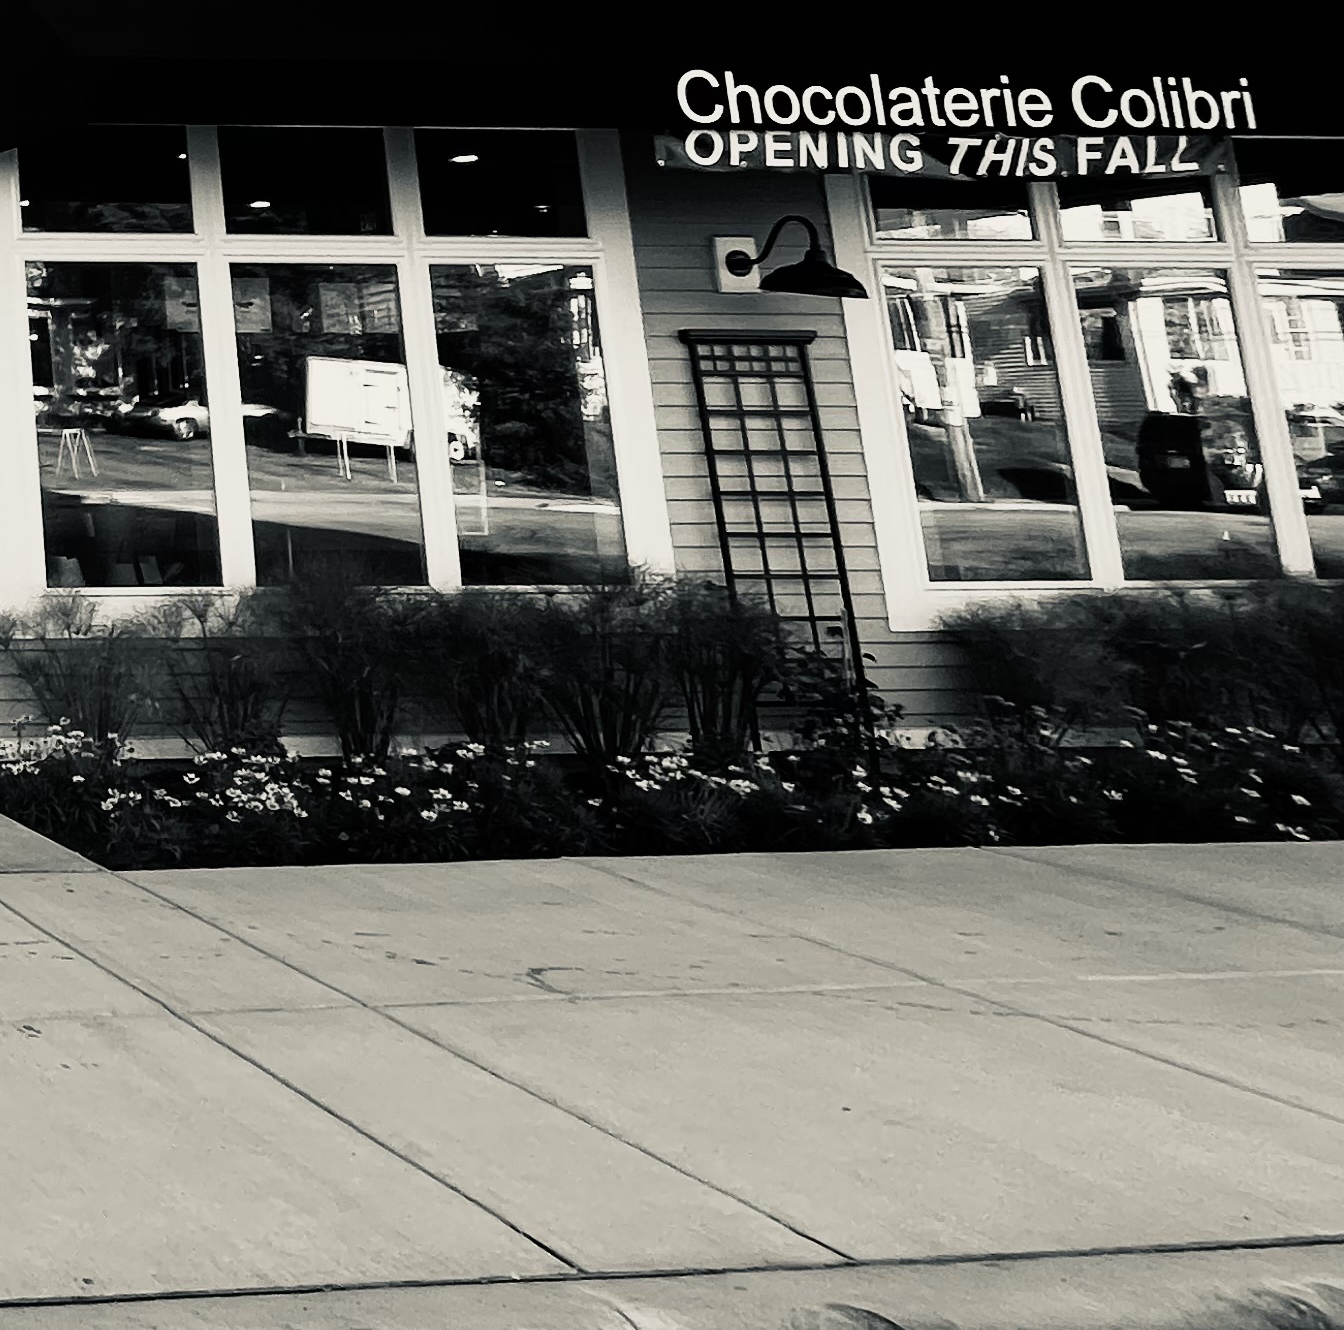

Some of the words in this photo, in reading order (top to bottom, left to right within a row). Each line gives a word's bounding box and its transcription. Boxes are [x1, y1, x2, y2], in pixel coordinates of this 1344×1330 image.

[676, 69, 1054, 128] Chocolaterie
[1071, 74, 1257, 130] Colibri
[684, 129, 924, 172] OPENING
[947, 136, 1057, 177] THIS
[1077, 135, 1200, 176] FALL
